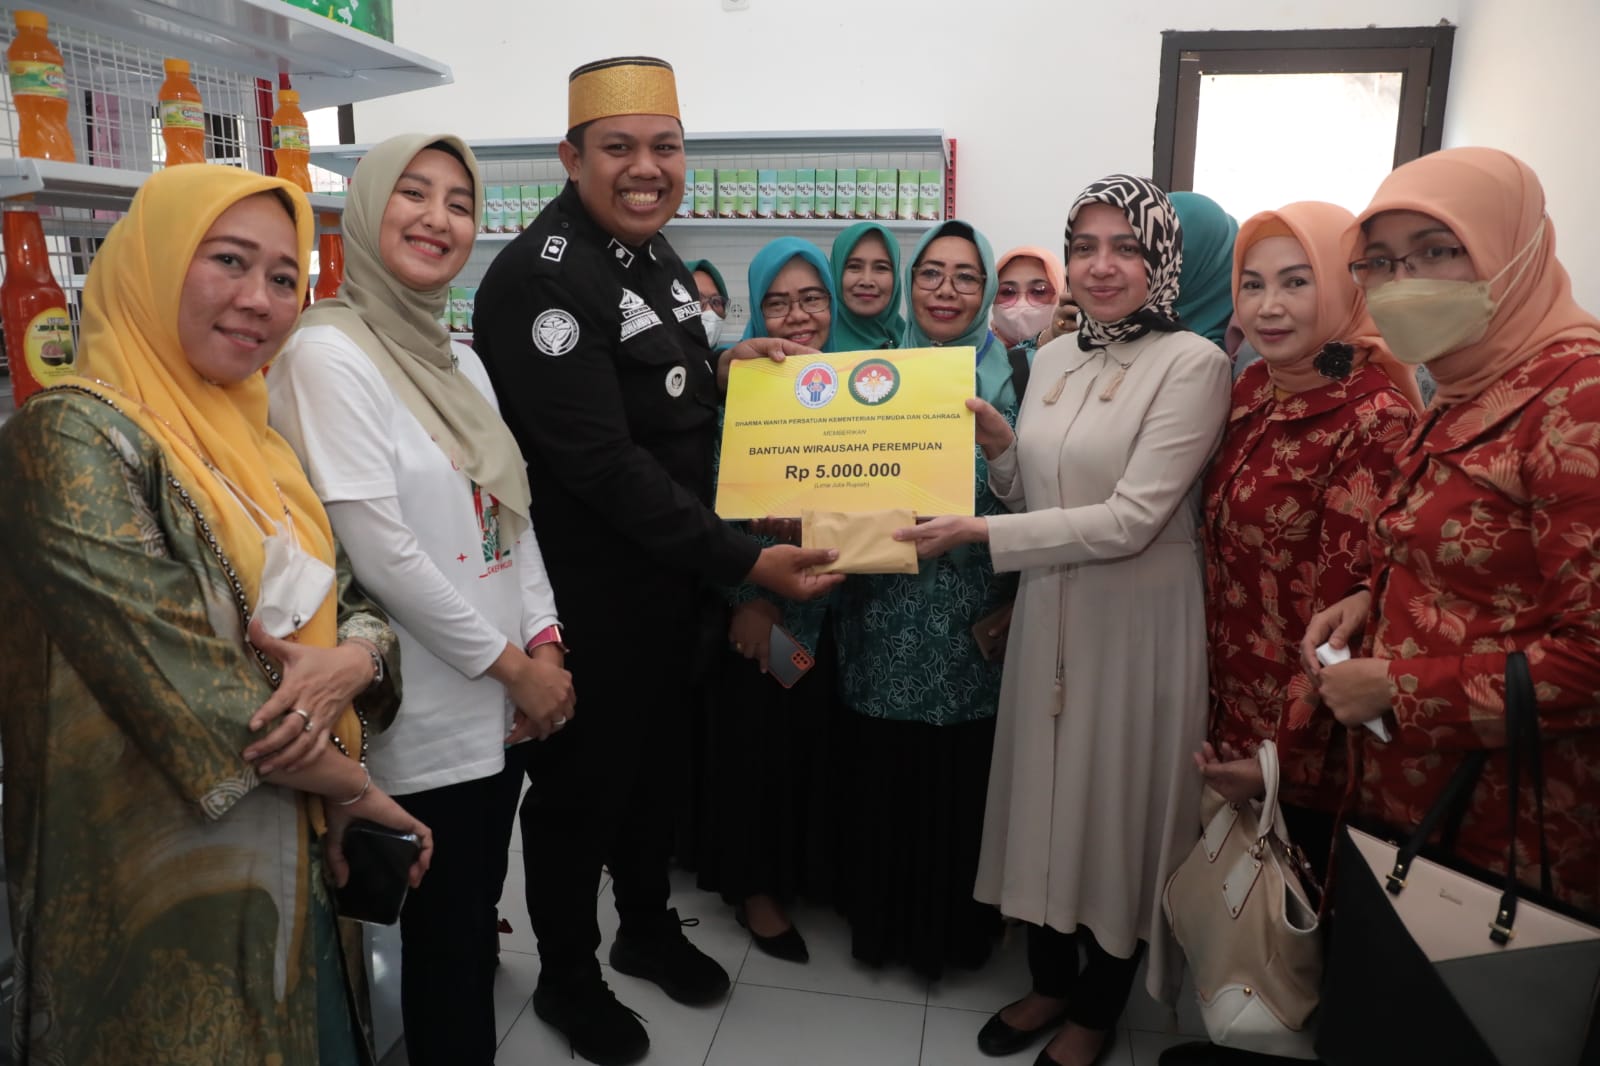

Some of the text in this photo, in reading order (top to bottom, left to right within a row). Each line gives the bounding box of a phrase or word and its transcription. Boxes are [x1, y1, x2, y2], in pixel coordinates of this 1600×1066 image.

[788, 417, 828, 425] PERSATUAN
[828, 415, 876, 423] KEMENTERIAN
[749, 442, 942, 455] BANTUAN WIRAUSAHA PEREMPUAN
[785, 463, 900, 482] Rp 5.000.000
